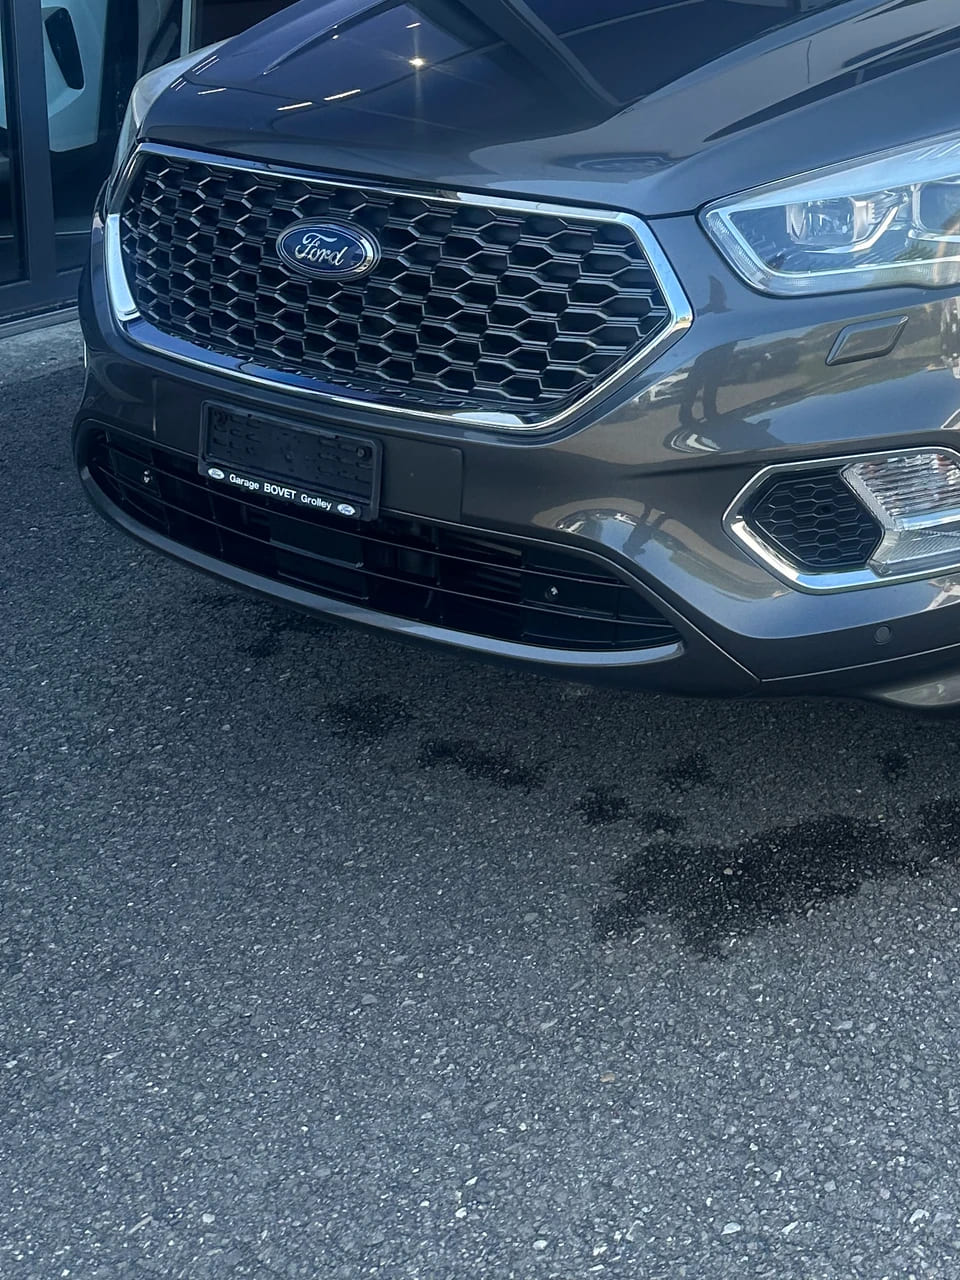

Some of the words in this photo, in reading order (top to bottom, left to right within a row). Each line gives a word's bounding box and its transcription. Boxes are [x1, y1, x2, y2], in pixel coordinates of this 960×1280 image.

[295, 232, 349, 266] Ford
[229, 473, 260, 490] Garage
[263, 483, 297, 499] BOVET
[301, 494, 333, 510] Grolley
